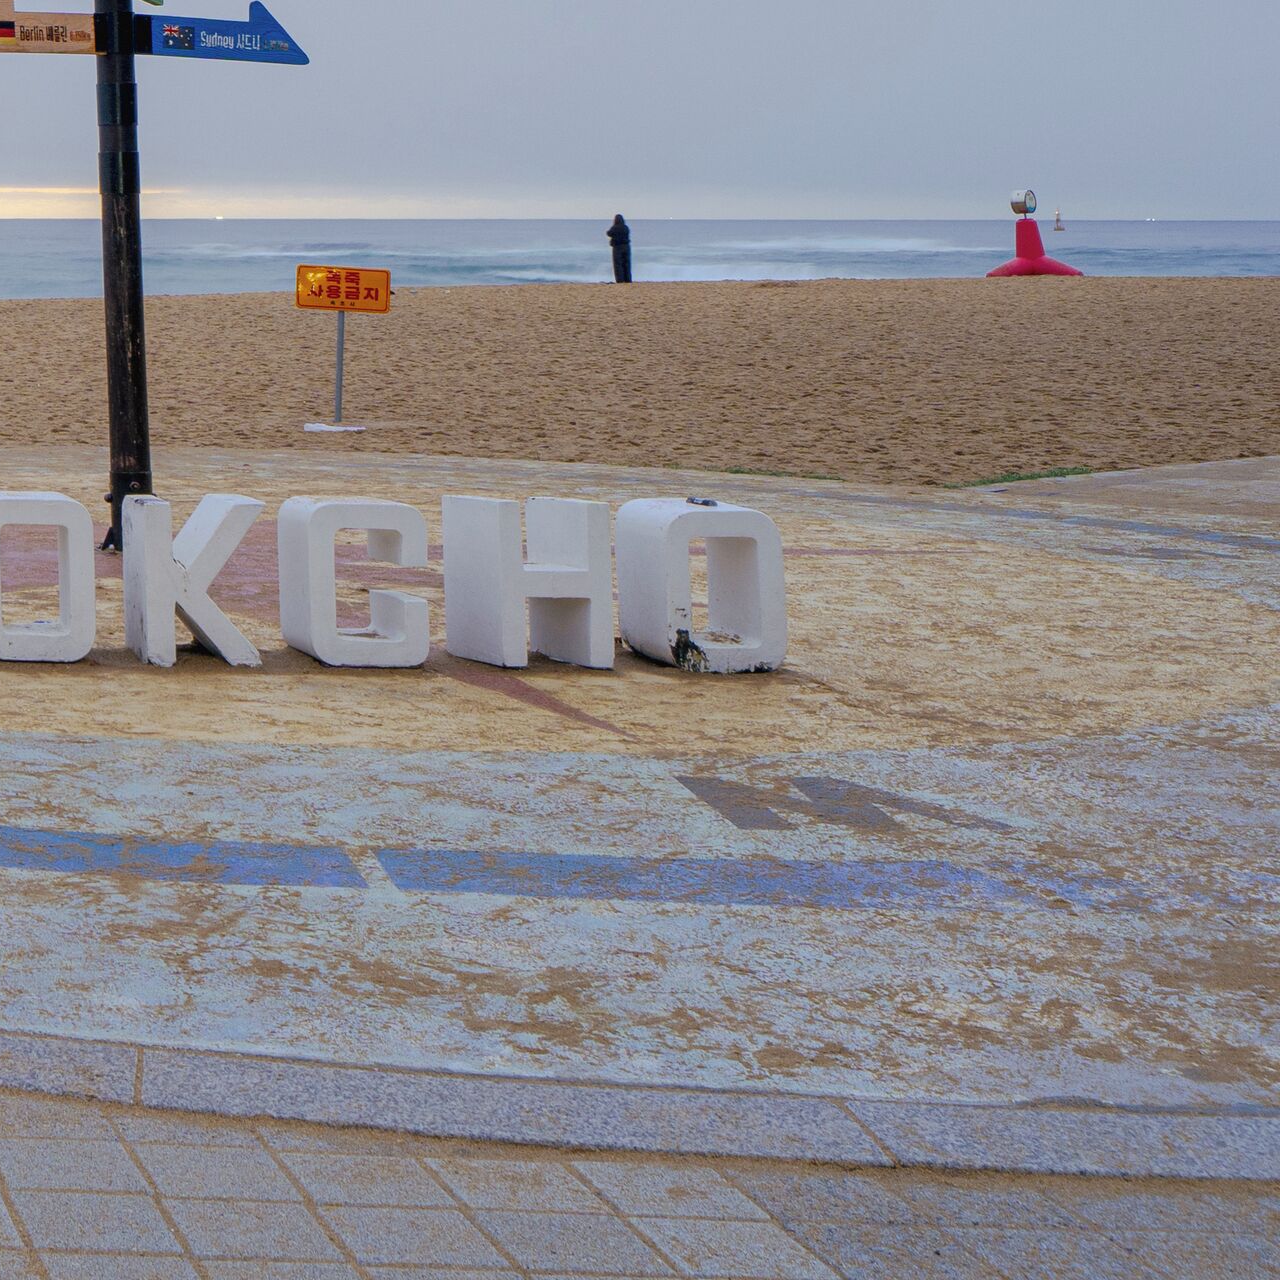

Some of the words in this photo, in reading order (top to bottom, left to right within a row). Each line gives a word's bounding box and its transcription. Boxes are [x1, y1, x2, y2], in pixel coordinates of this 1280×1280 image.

[19, 25, 44, 42] Berlin
[46, 25, 68, 43] 베를린
[200, 30, 234, 50] Sydney
[236, 33, 261, 51] 시드니
[307, 285, 379, 301] 사용금지
